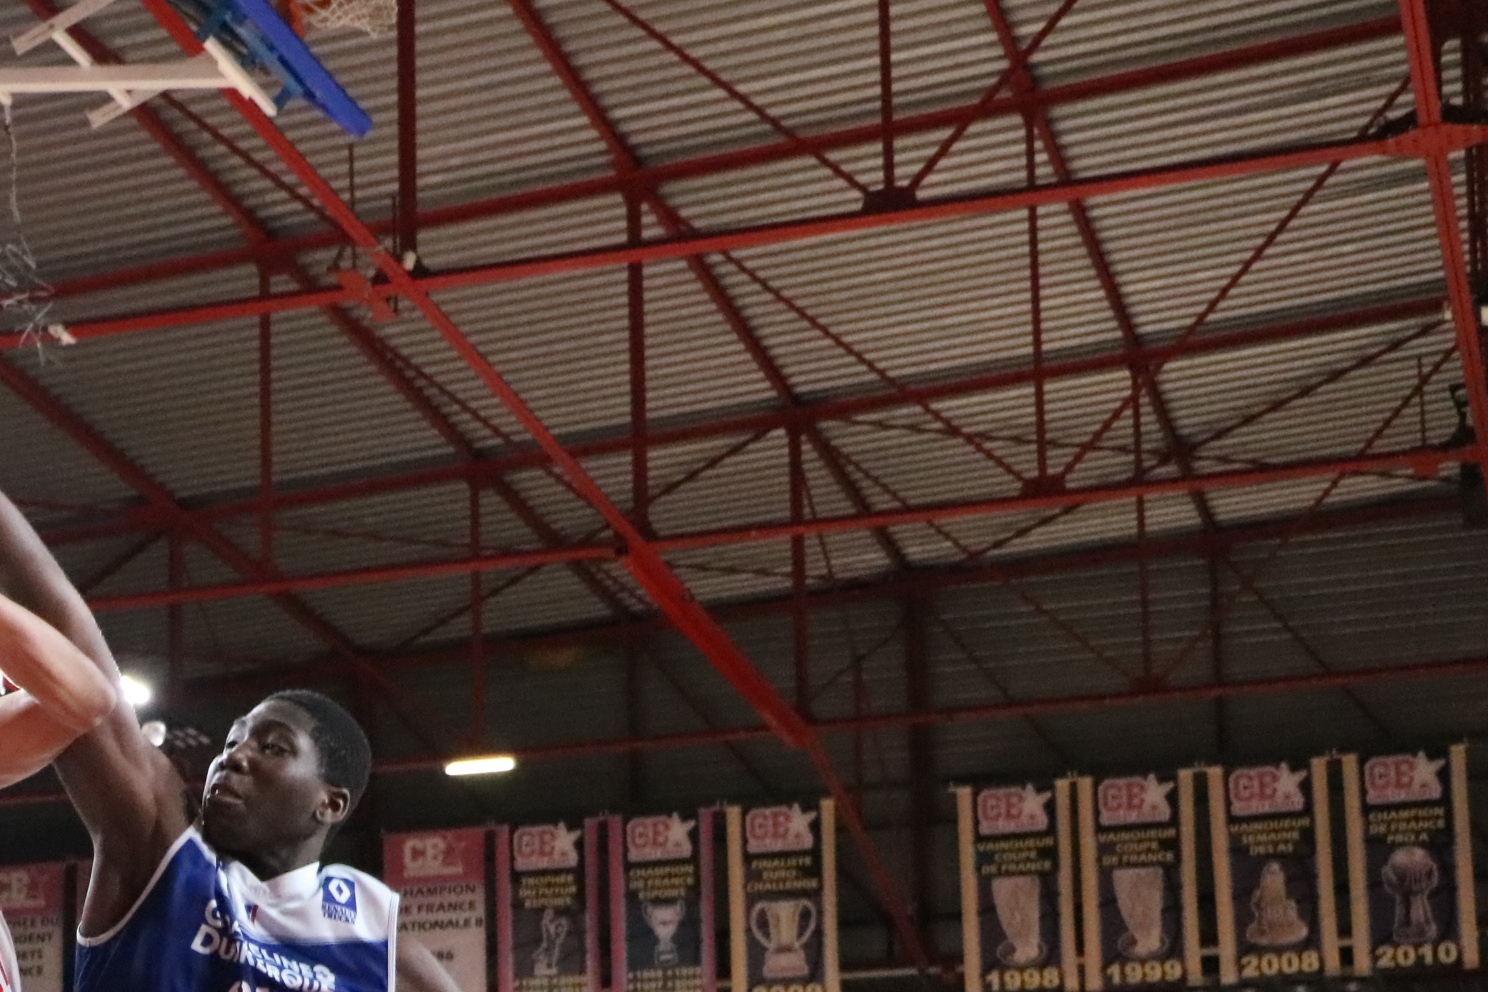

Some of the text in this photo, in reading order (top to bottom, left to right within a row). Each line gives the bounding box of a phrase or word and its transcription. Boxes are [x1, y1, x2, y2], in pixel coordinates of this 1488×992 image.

[401, 884, 476, 898] HAMPION
[417, 901, 476, 914] FRANCE
[398, 917, 473, 932] ATIONALE
[1239, 950, 1320, 978] 2008
[1375, 940, 1459, 966] 2010
[985, 968, 1061, 992] 1998
[1106, 958, 1183, 986] 1999
